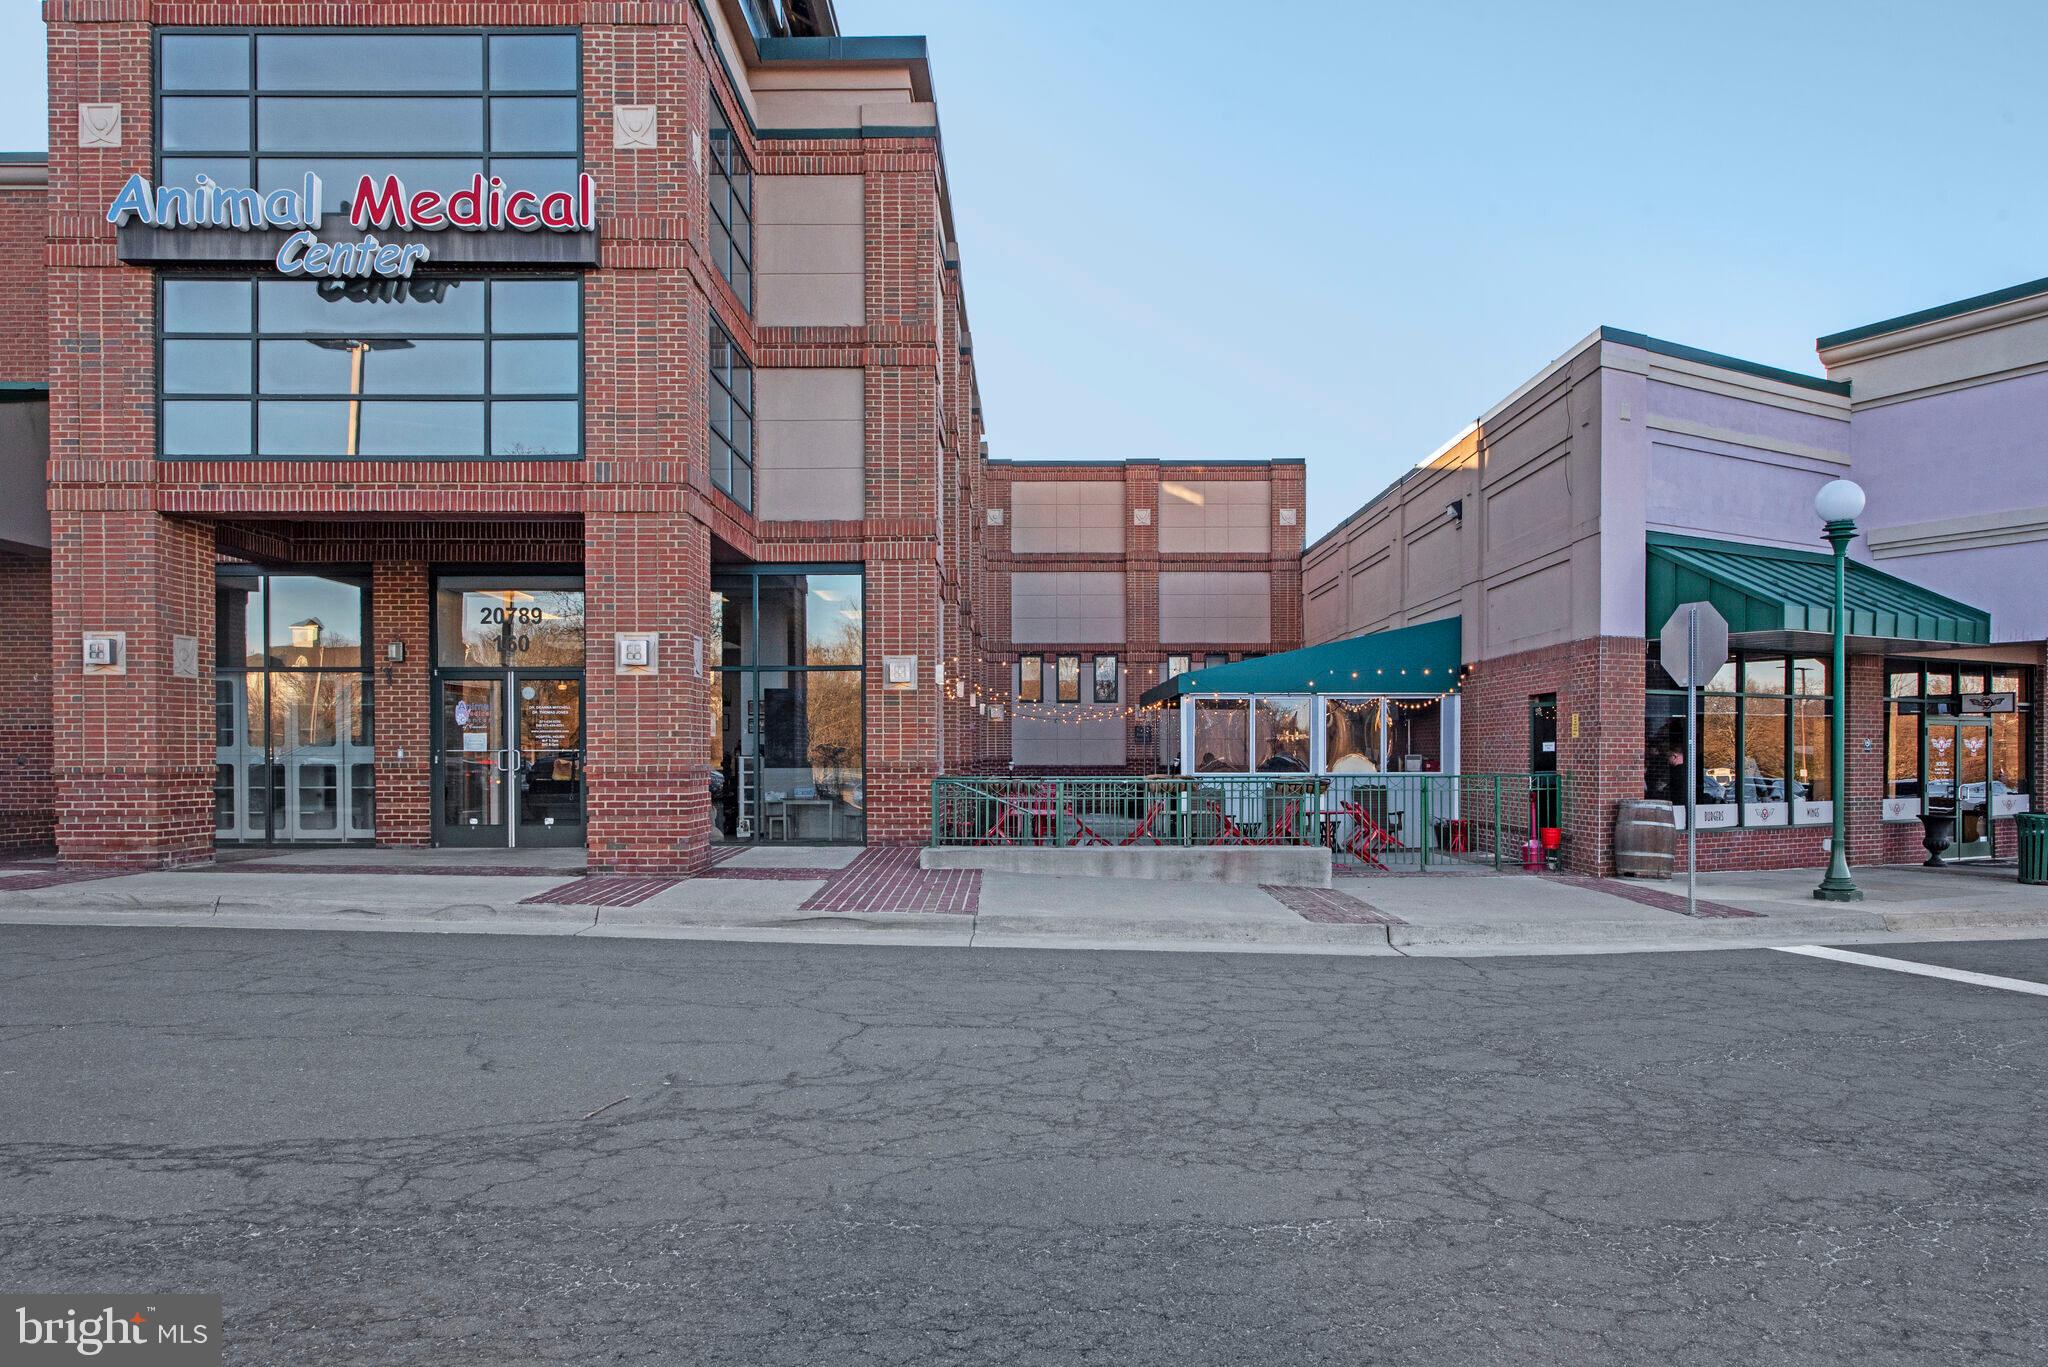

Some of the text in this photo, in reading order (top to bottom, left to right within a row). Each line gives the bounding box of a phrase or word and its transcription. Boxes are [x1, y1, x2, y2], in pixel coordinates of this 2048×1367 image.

[105, 170, 597, 231] Animal Medical
[276, 230, 430, 278] Center
[480, 606, 543, 625] 20789
[493, 634, 530, 652] 160
